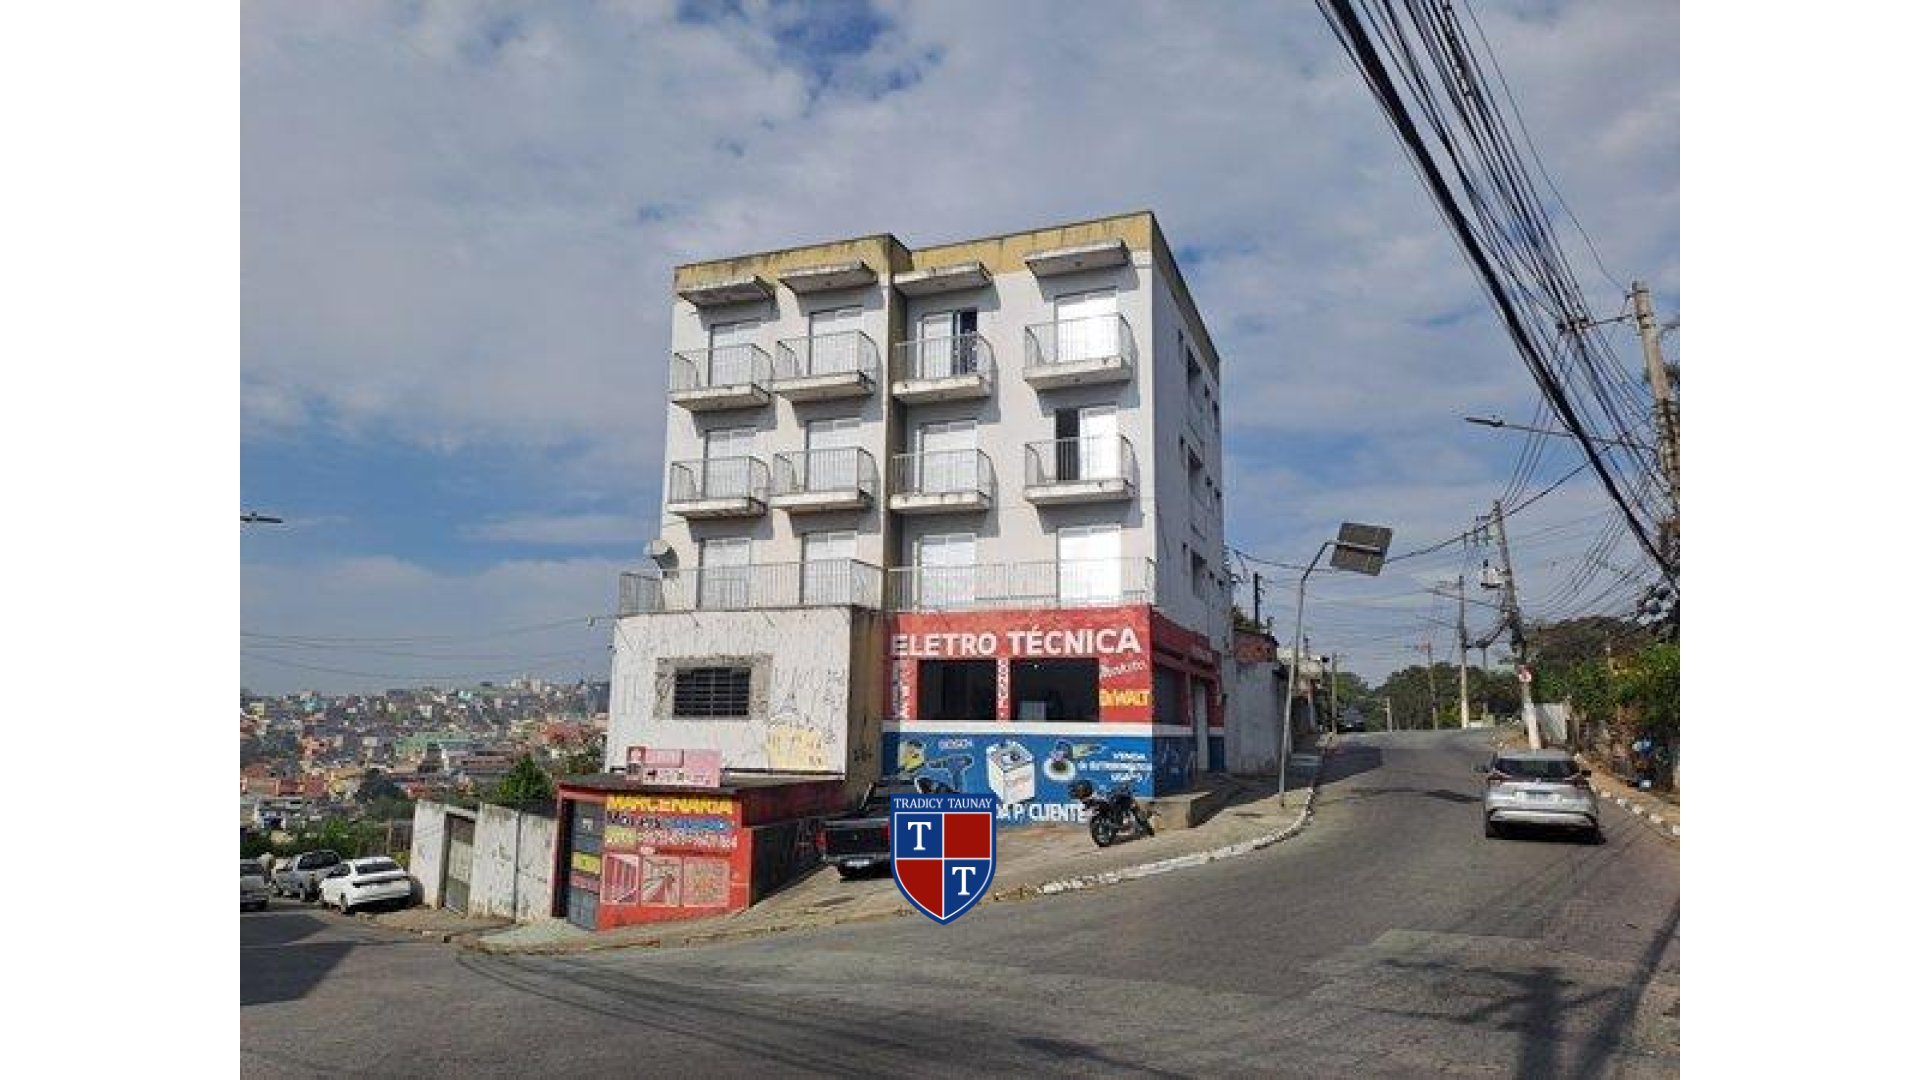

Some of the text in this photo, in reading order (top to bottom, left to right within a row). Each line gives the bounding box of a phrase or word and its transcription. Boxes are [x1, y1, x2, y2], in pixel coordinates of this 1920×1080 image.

[892, 625, 1141, 656] ELETRO TÉCNICA
[606, 795, 734, 815] MARCENARIA
[1029, 803, 1088, 822] CLIENTE
